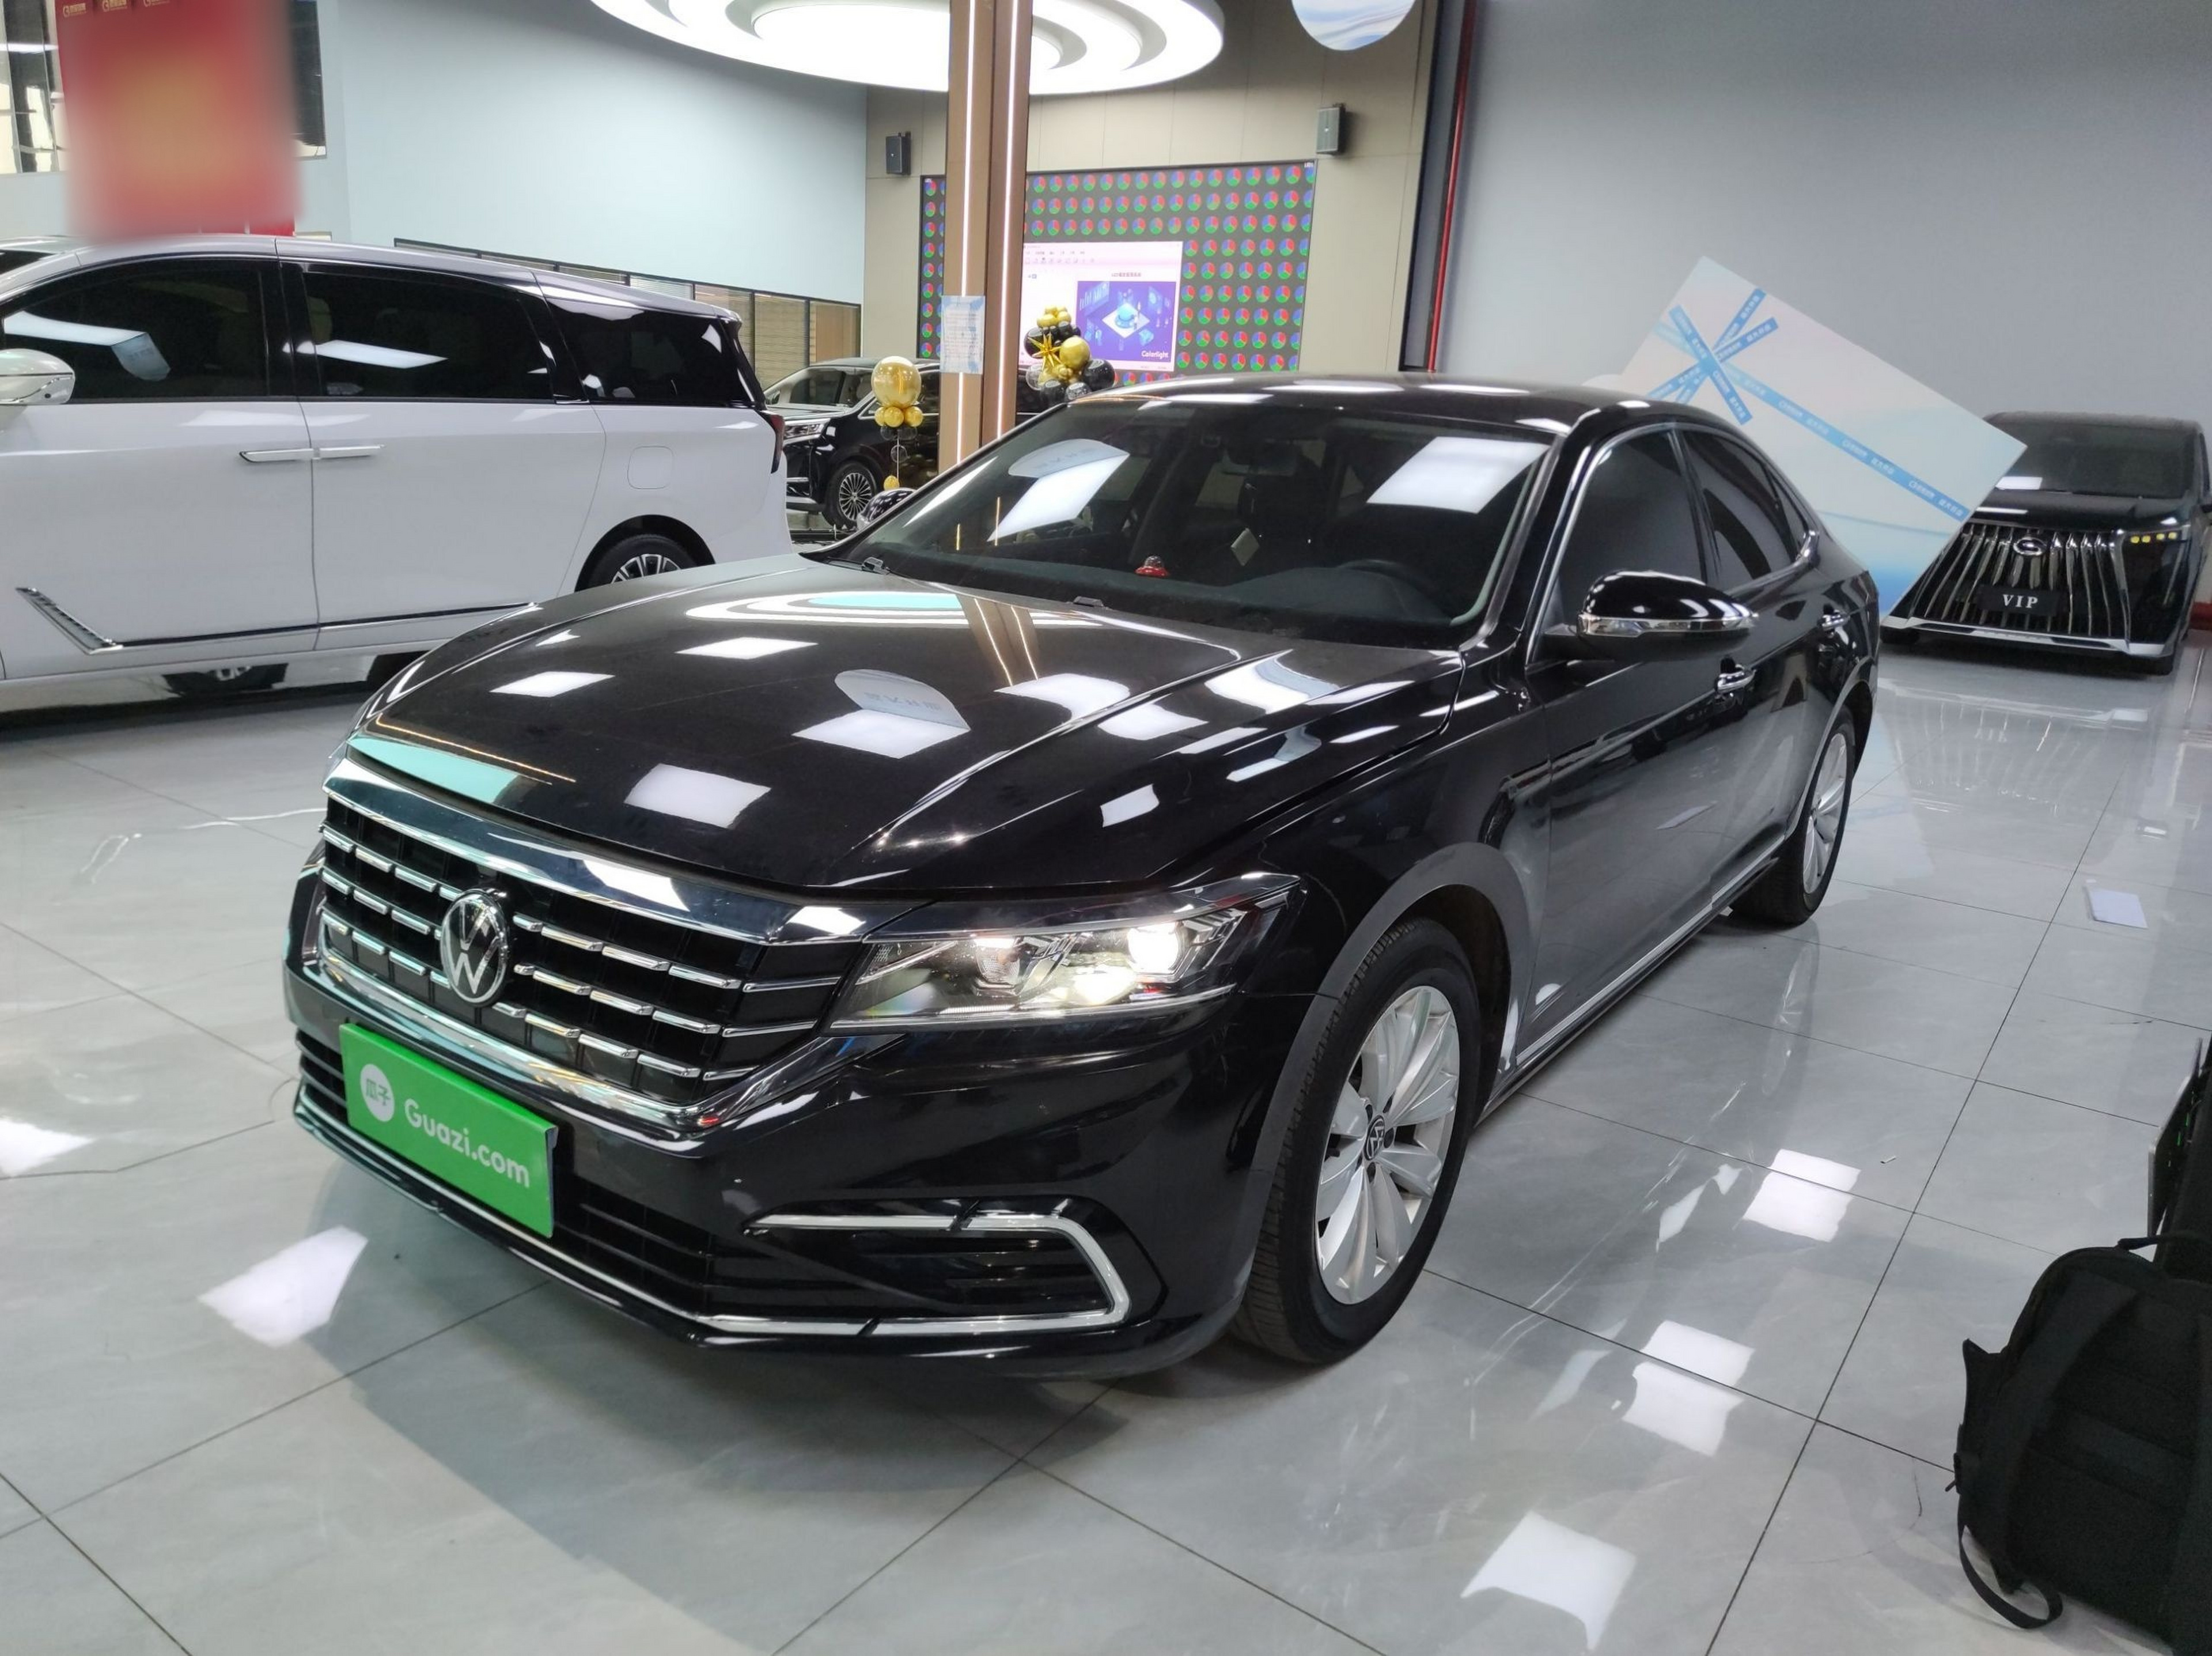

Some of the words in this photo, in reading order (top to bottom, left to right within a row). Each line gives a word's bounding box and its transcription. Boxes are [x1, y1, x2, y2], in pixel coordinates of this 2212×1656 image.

[2002, 594, 2039, 608] VIP
[366, 1078, 391, 1106] 瓜子
[404, 1098, 530, 1189] Guazi.com
